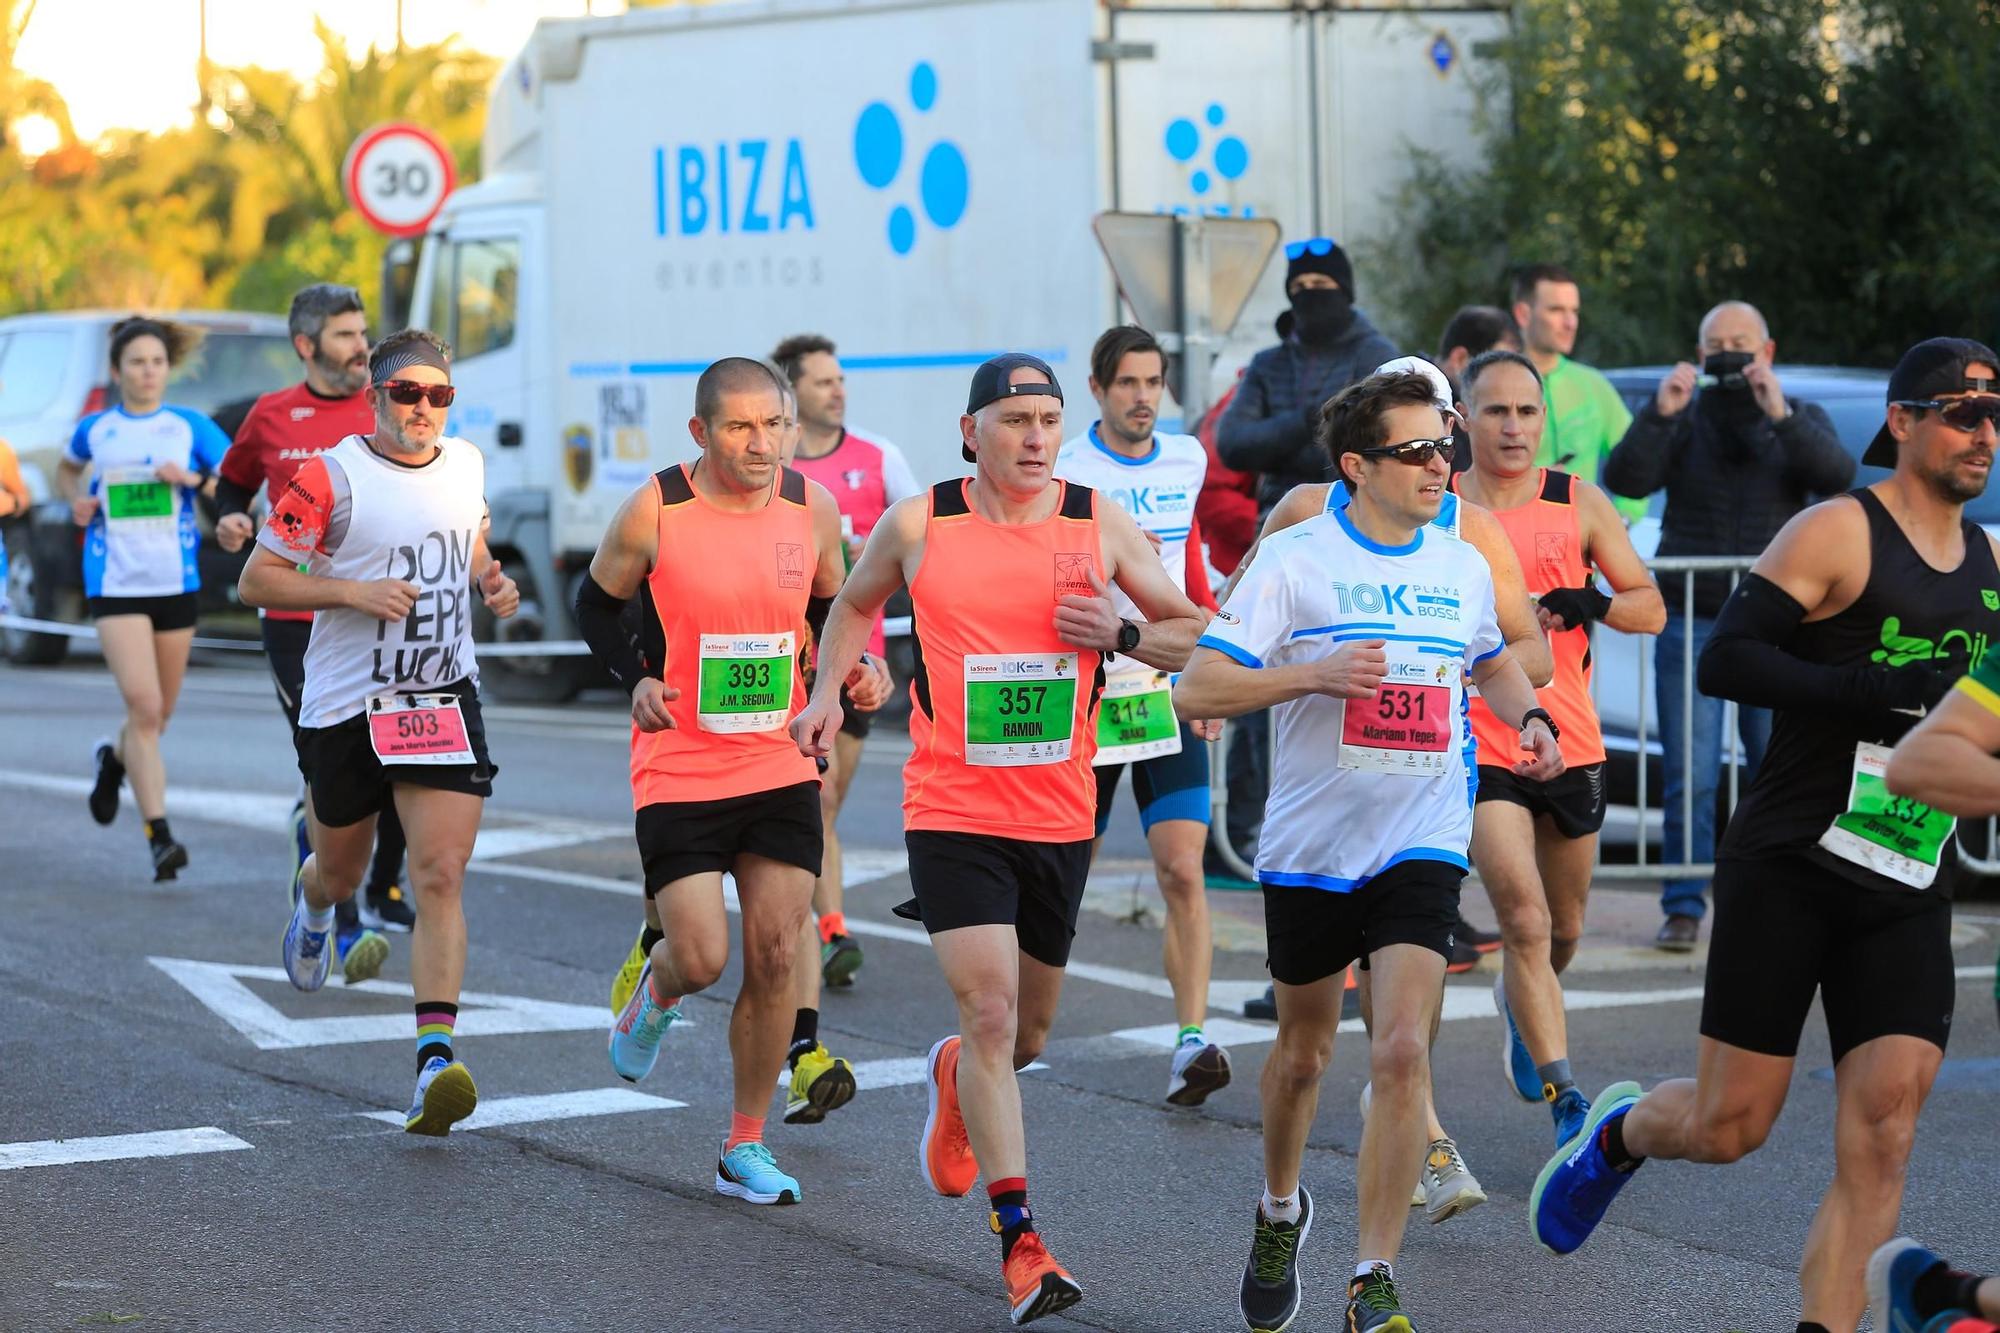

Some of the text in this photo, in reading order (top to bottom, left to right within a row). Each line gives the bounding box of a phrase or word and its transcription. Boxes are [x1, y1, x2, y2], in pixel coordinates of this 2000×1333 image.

[376, 161, 430, 198] 30
[655, 139, 815, 236] IBIZA
[655, 256, 824, 291] eventos
[387, 529, 471, 583] DON
[1332, 582, 1414, 616] 10K
[1413, 585, 1460, 596] PLAYA
[377, 588, 465, 643] EPE
[1418, 605, 1461, 622] BOSSA
[728, 663, 770, 688] 393
[1000, 661, 1026, 673] 10K
[719, 693, 775, 707] J.M. SEGOVIA
[998, 686, 1047, 715] 357
[1108, 698, 1149, 725] 314
[1378, 690, 1425, 721] 531
[398, 713, 438, 738] 503
[1003, 722, 1043, 737] RAMON
[1363, 725, 1438, 745] Mariano Yepes
[1883, 796, 1931, 830] 332
